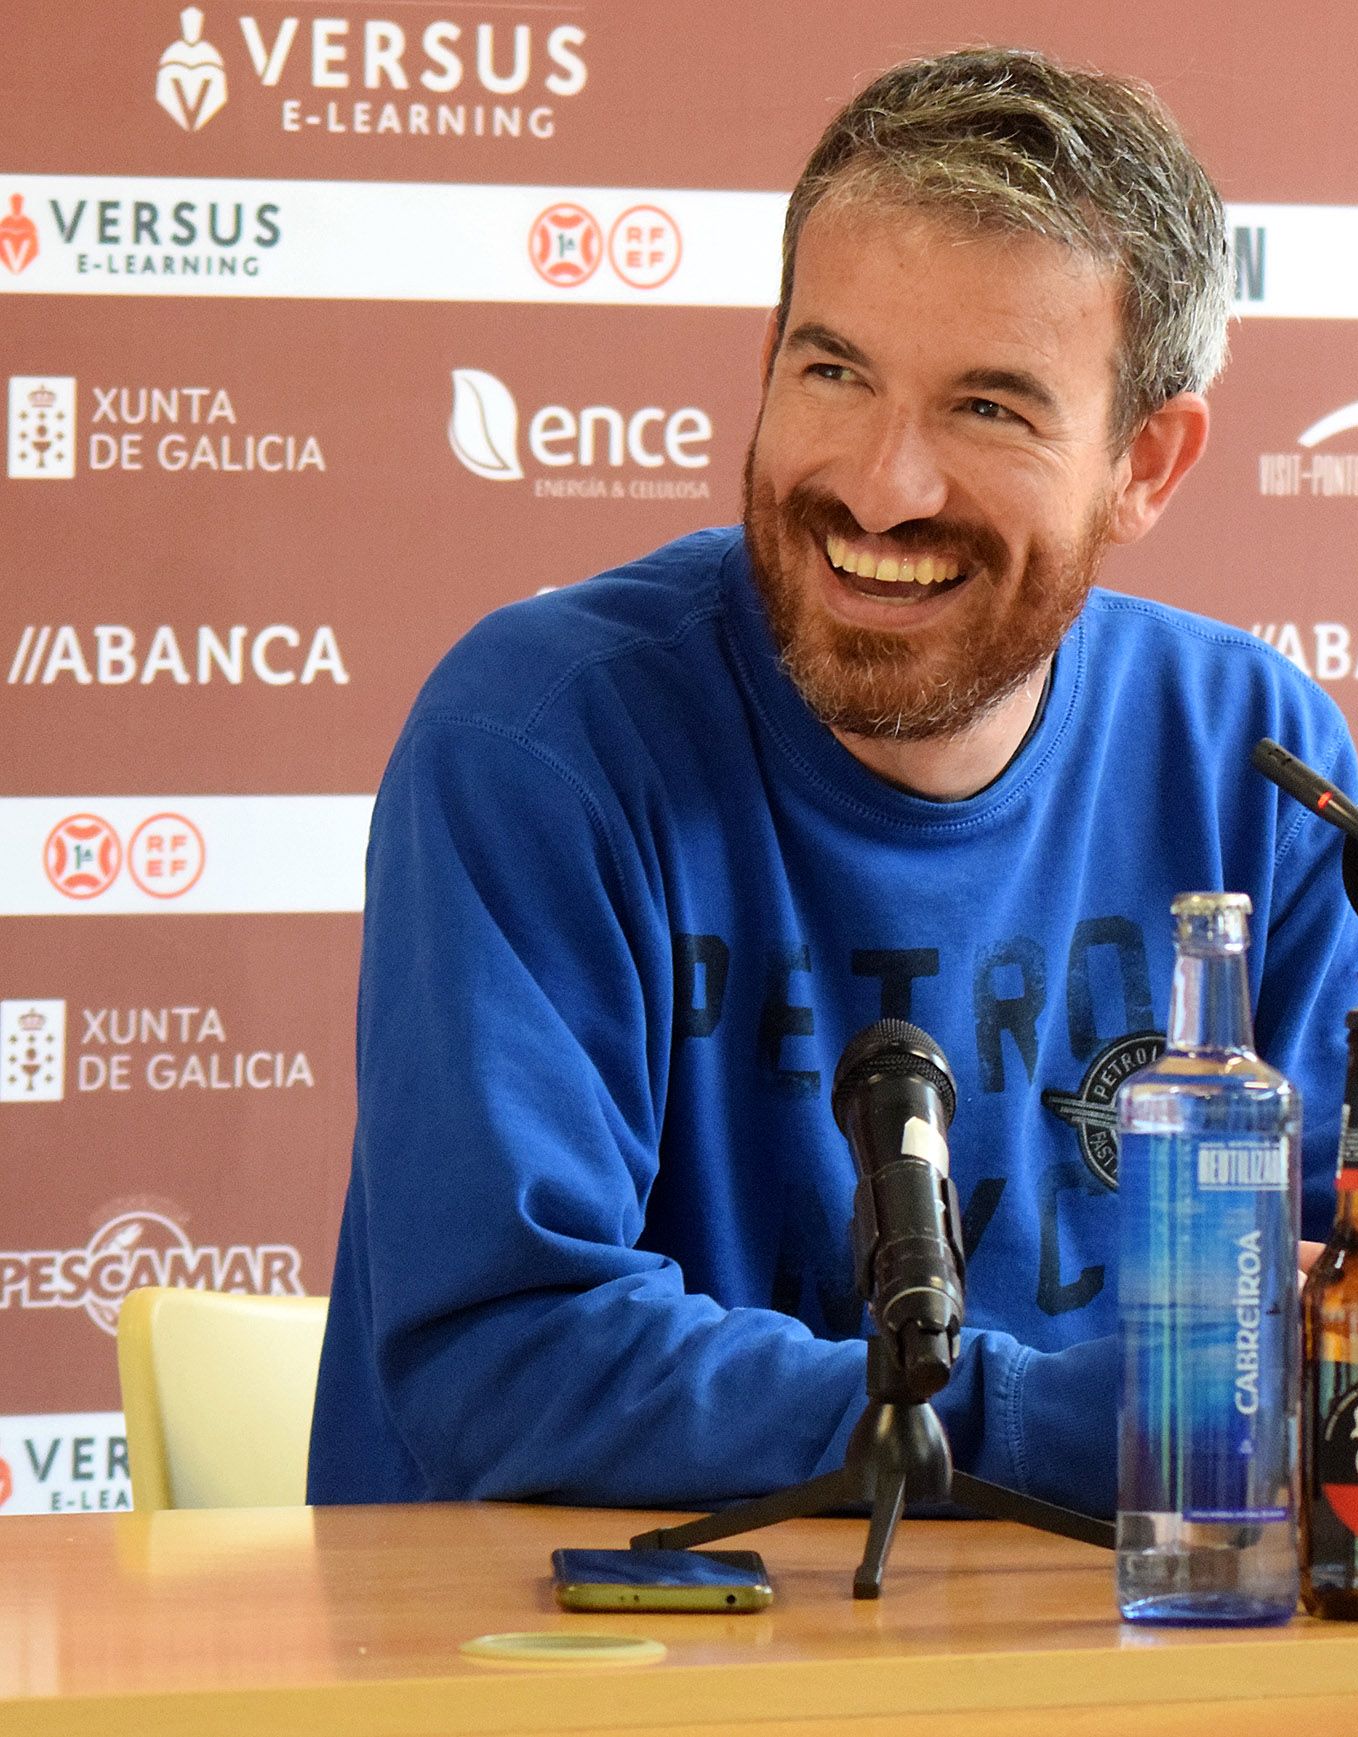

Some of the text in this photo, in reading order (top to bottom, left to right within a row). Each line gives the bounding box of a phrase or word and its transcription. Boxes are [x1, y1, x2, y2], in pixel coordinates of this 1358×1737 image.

[240, 16, 588, 96] VERSUS
[282, 100, 556, 139] E-LEARNING
[50, 199, 282, 249] VERSUS
[77, 253, 260, 277] E-LEARNING
[91, 386, 237, 425] XUNTA
[90, 434, 326, 473] DE GALICIA
[528, 405, 713, 468] ence
[82, 1005, 227, 1045] XUNTA
[78, 1052, 315, 1091] DE GALICIA
